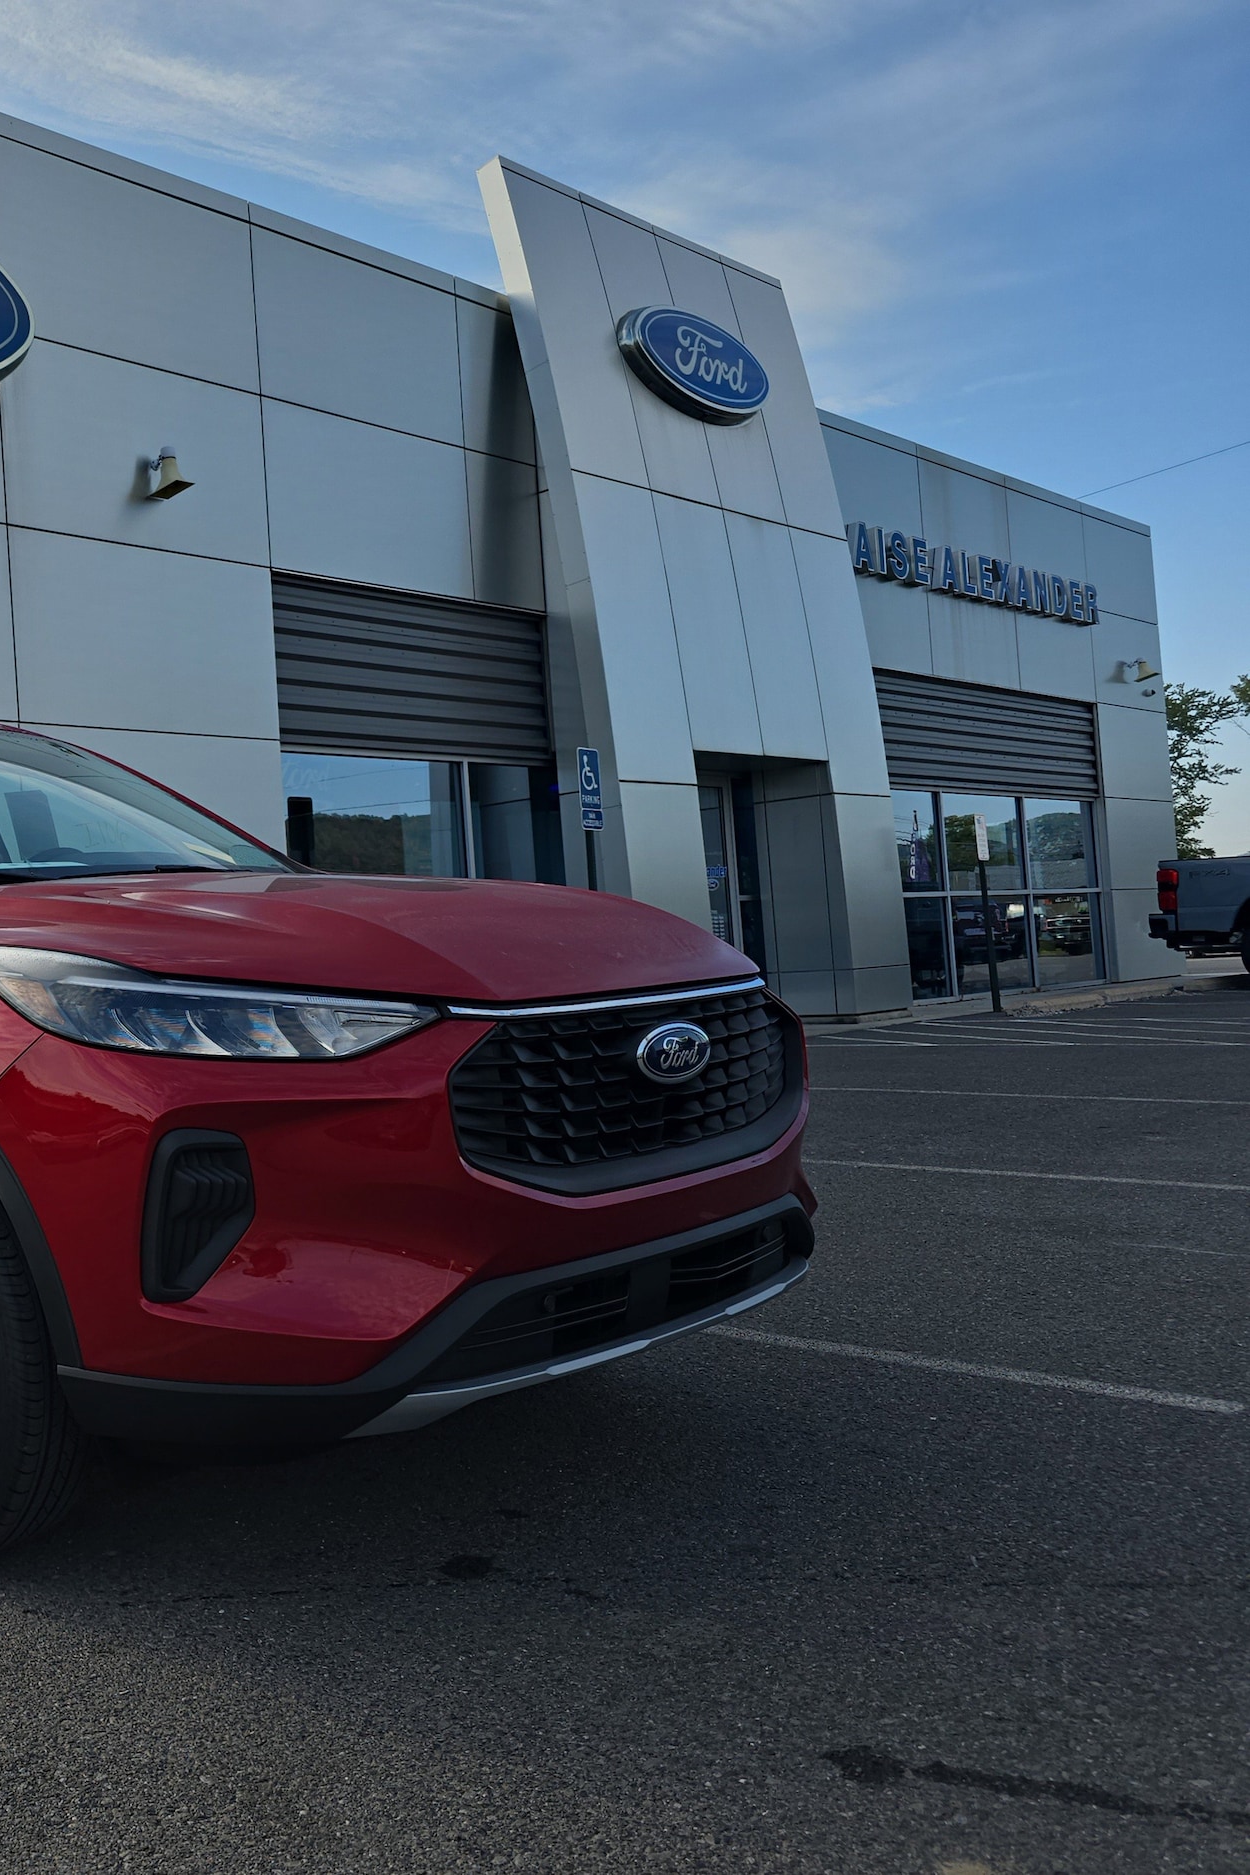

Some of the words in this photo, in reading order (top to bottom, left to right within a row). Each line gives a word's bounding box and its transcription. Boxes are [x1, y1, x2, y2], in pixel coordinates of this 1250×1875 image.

[675, 325, 747, 394] Ford
[940, 545, 1099, 624] ALEXANDER
[582, 794, 600, 805] PARKING
[660, 1036, 699, 1069] Ford
